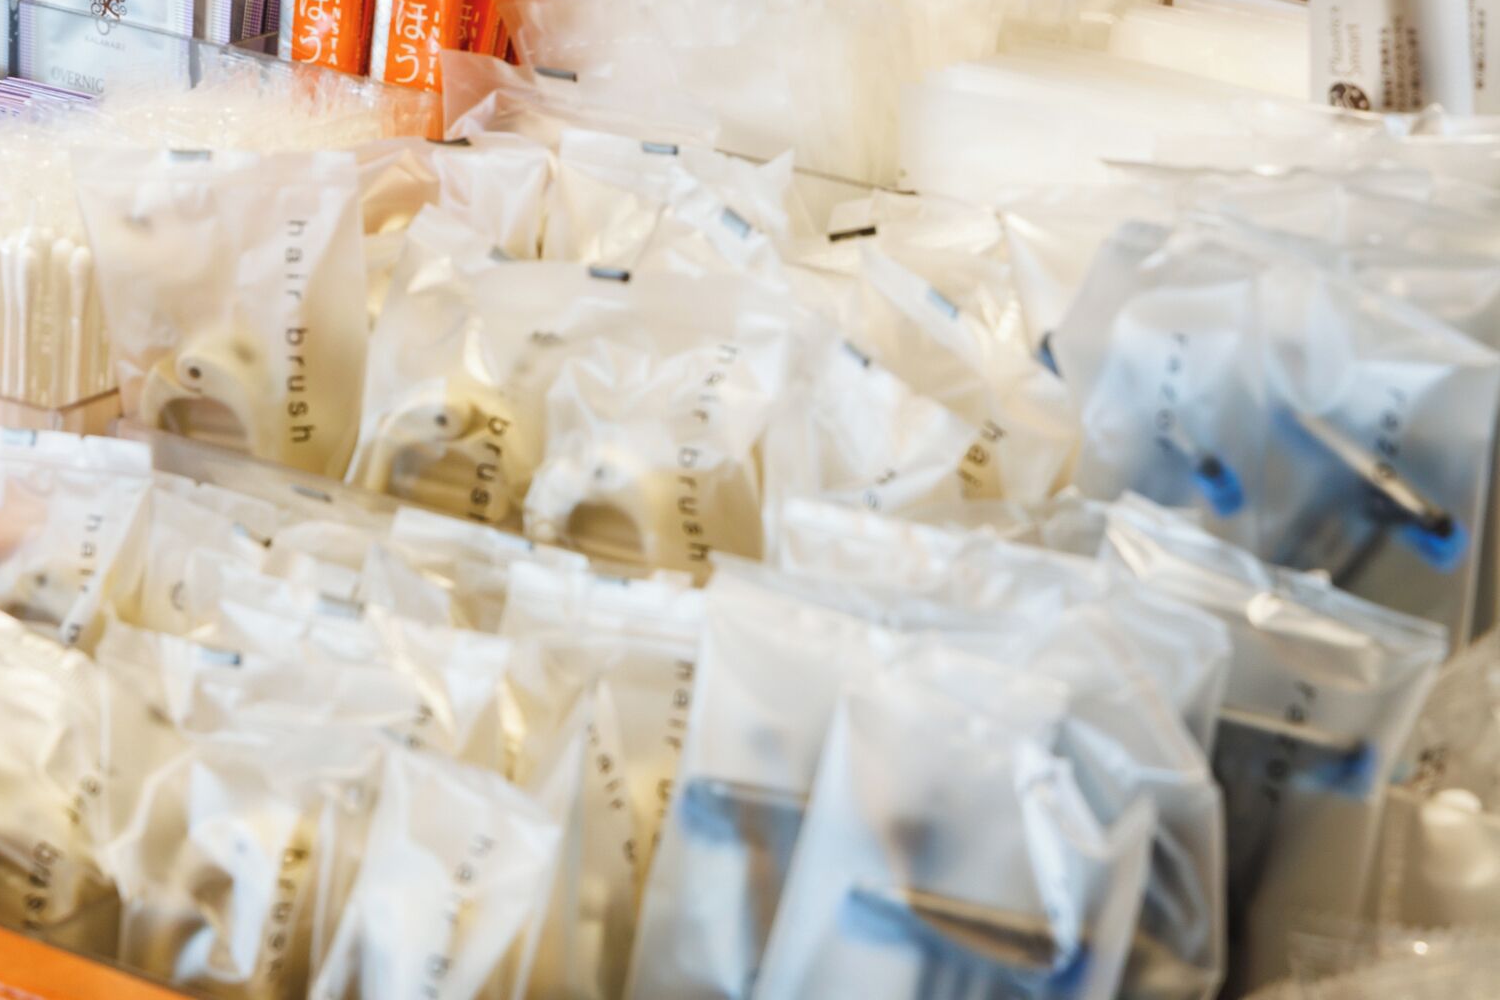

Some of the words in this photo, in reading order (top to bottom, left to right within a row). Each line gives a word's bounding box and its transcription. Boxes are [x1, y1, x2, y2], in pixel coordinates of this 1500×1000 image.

[52, 66, 105, 94] OVERNIG
[425, 10, 441, 88] INSTA
[284, 219, 308, 300] hair
[284, 327, 316, 444] brush
[677, 446, 713, 564] brush
